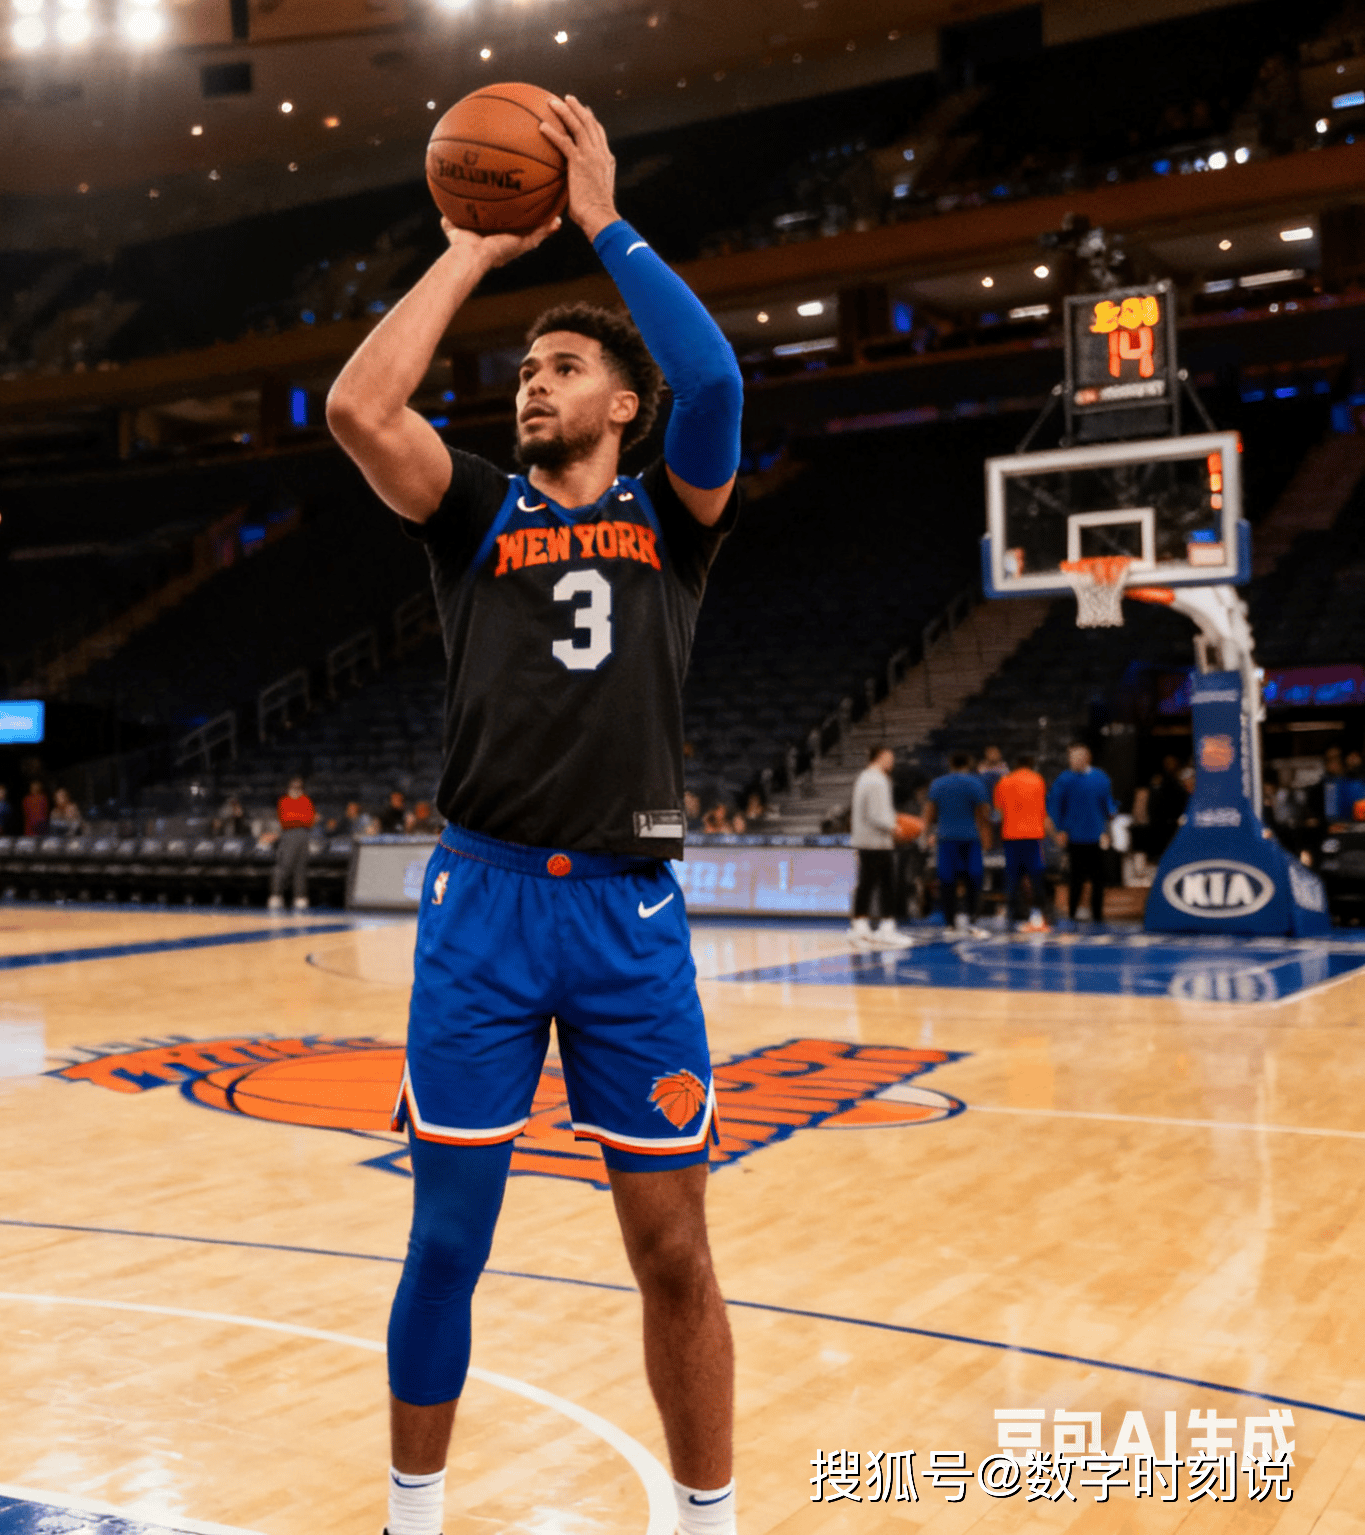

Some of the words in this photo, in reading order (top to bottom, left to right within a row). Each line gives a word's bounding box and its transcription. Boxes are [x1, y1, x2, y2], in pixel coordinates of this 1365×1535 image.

[1108, 326, 1154, 378] 14
[495, 526, 571, 577] NEW
[572, 520, 662, 571] YORK
[552, 569, 612, 670] 3
[1182, 871, 1256, 907] KIA
